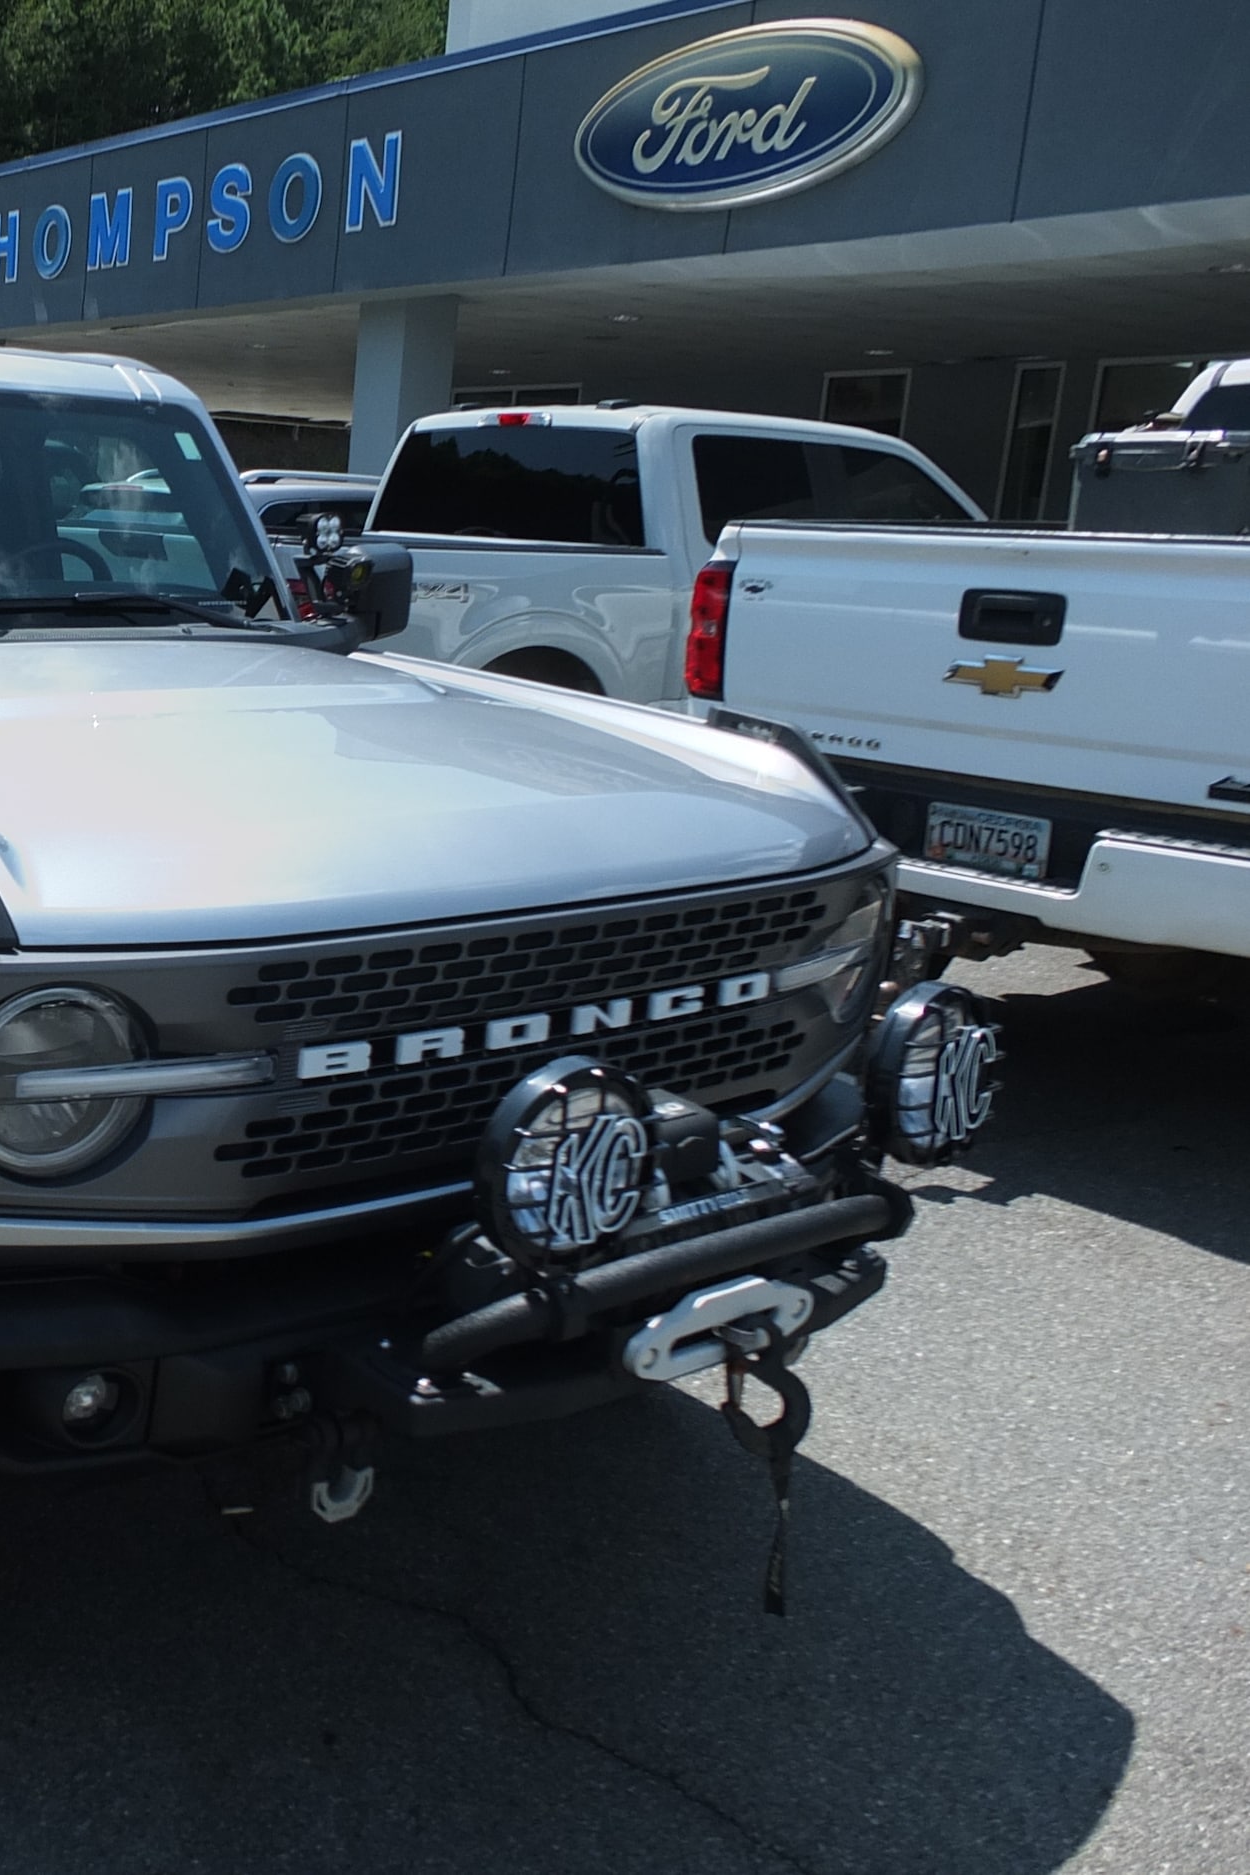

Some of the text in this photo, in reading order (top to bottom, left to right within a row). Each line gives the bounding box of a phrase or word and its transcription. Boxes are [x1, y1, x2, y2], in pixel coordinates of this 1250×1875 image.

[632, 65, 817, 174] Ford
[940, 820, 1038, 863] CDN7598
[297, 972, 770, 1080] BRONCO
[935, 1024, 997, 1140] KC
[550, 1114, 648, 1245] KC
